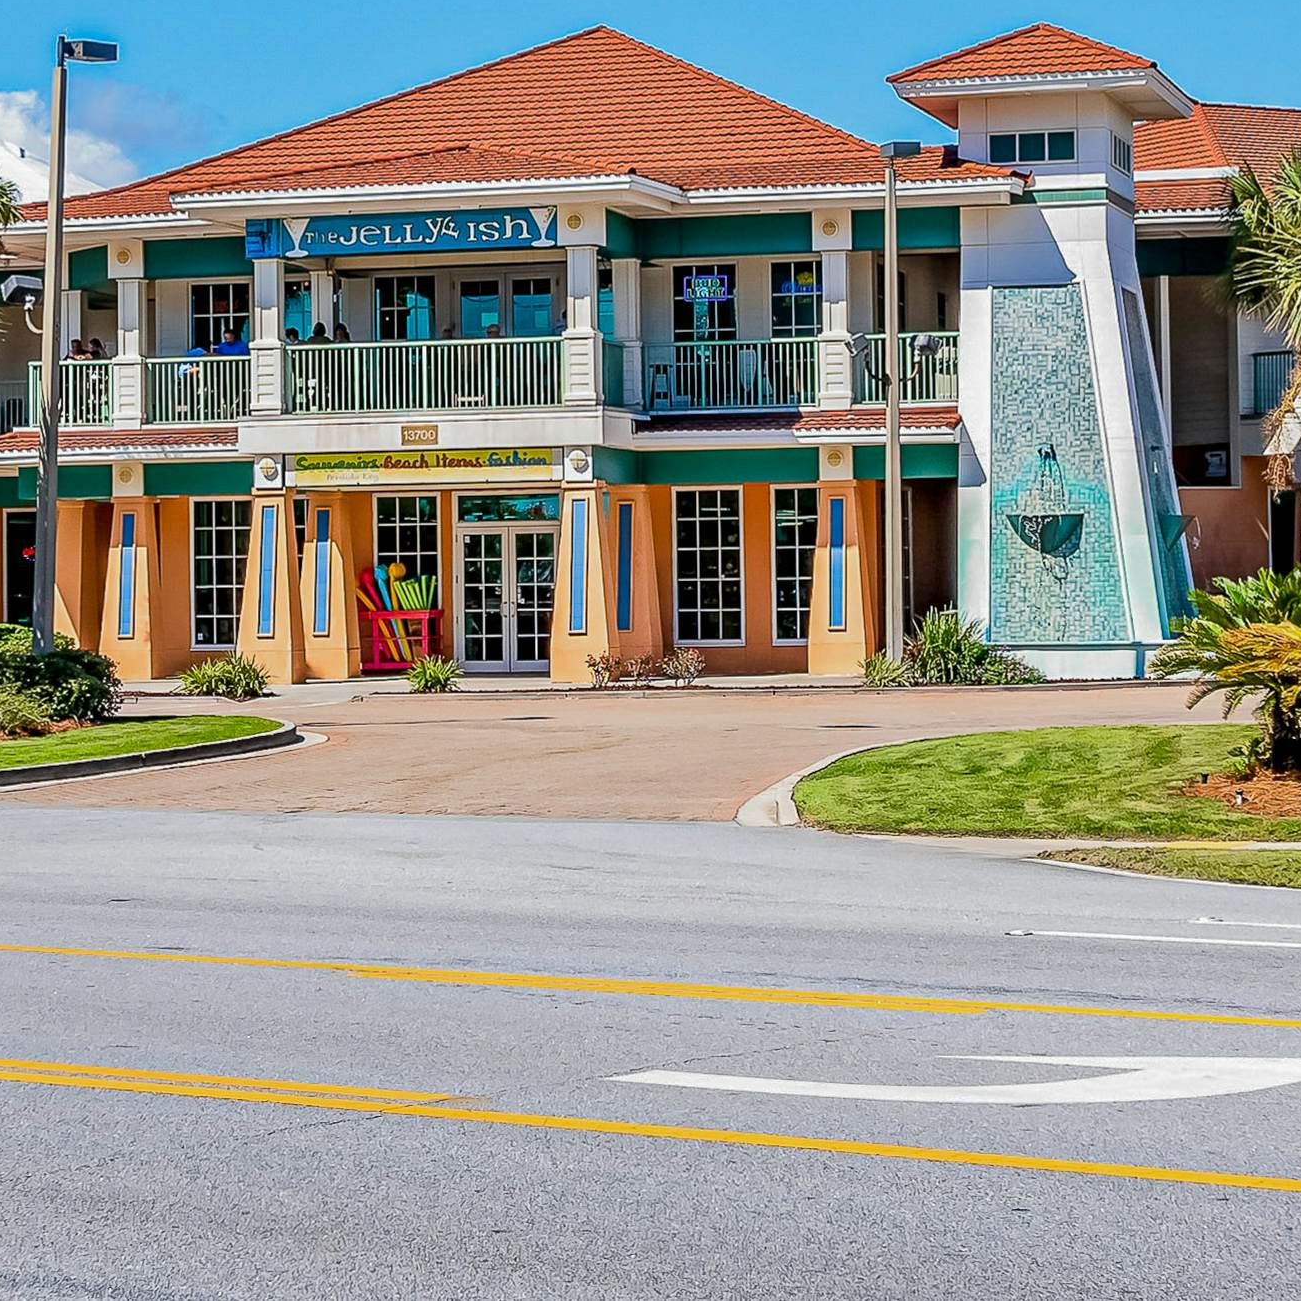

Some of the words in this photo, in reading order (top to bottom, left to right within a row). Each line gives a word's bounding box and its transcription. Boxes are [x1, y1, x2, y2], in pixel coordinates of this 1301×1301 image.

[402, 429, 436, 441] 13700
[383, 453, 429, 470] Beach
[436, 452, 483, 468] Items
